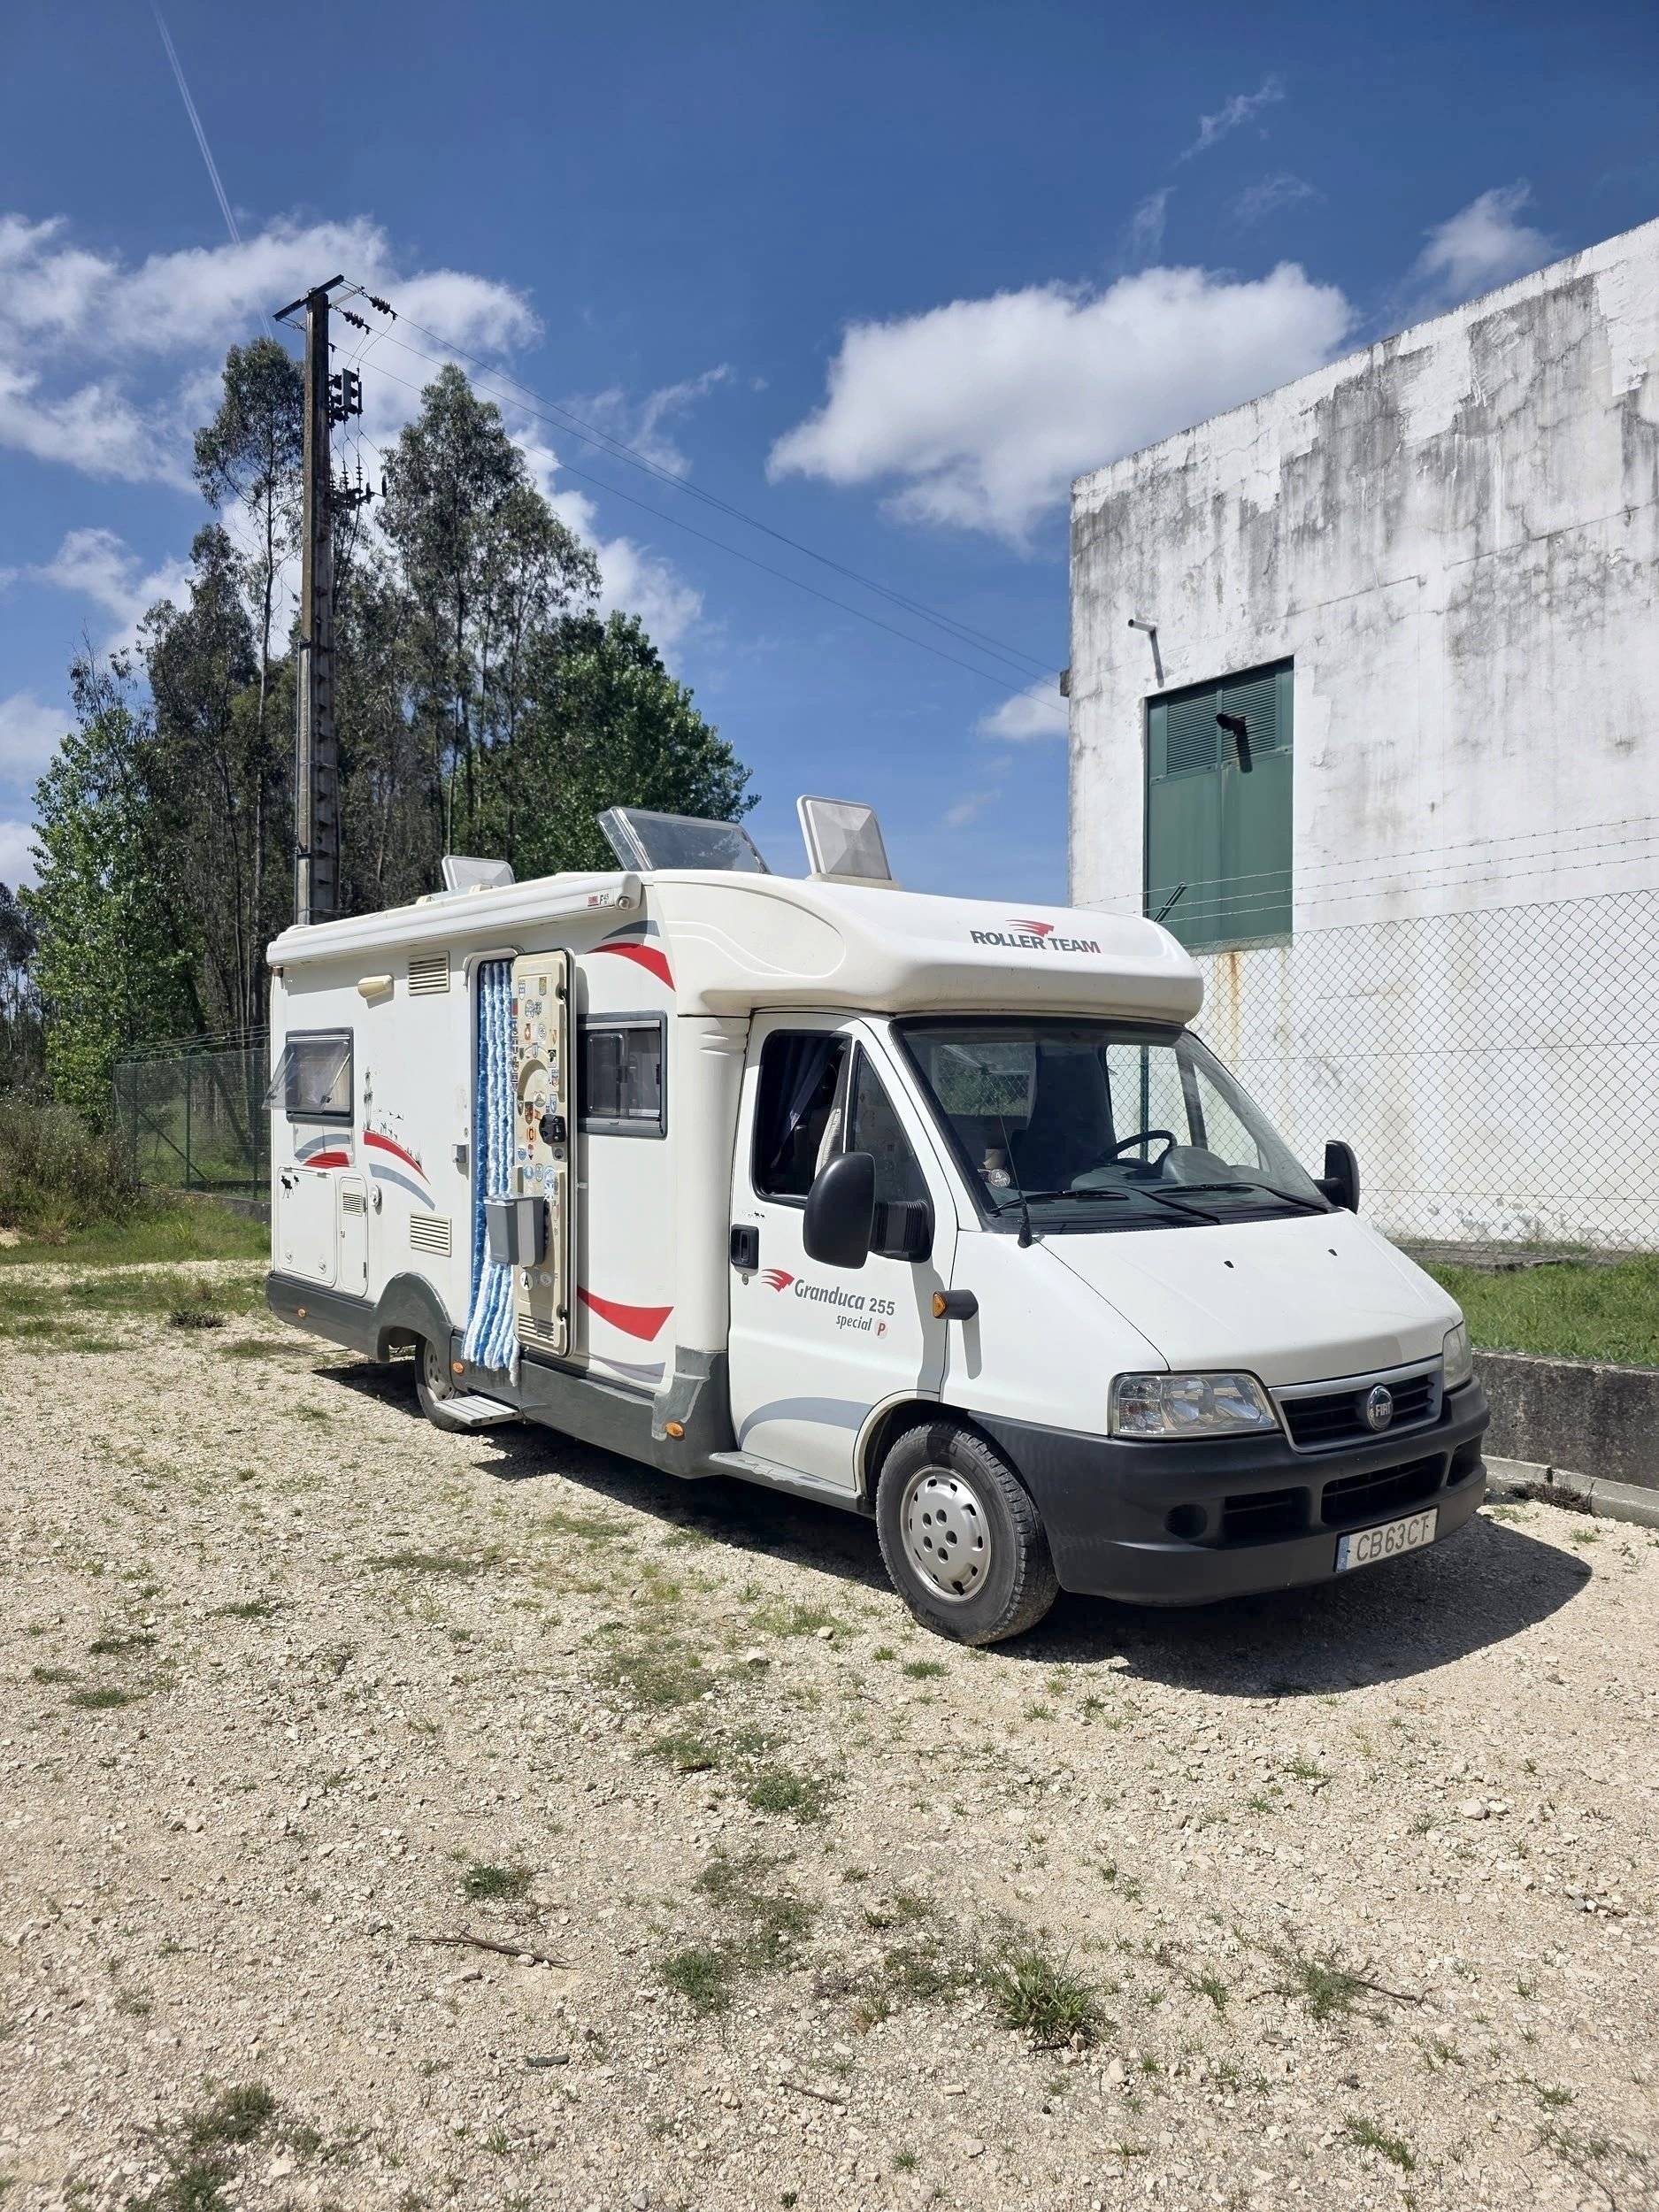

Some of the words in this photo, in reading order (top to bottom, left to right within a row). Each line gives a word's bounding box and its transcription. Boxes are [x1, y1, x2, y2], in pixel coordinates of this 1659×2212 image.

[970, 930, 1047, 950] ROLLER
[1048, 937, 1102, 954] TEAM
[795, 1279, 865, 1310] Granduca
[869, 1297, 895, 1317] 255
[835, 1314, 872, 1332] special
[1375, 1402, 1391, 1417] FIAT
[1356, 1514, 1429, 1562] CB63CT
